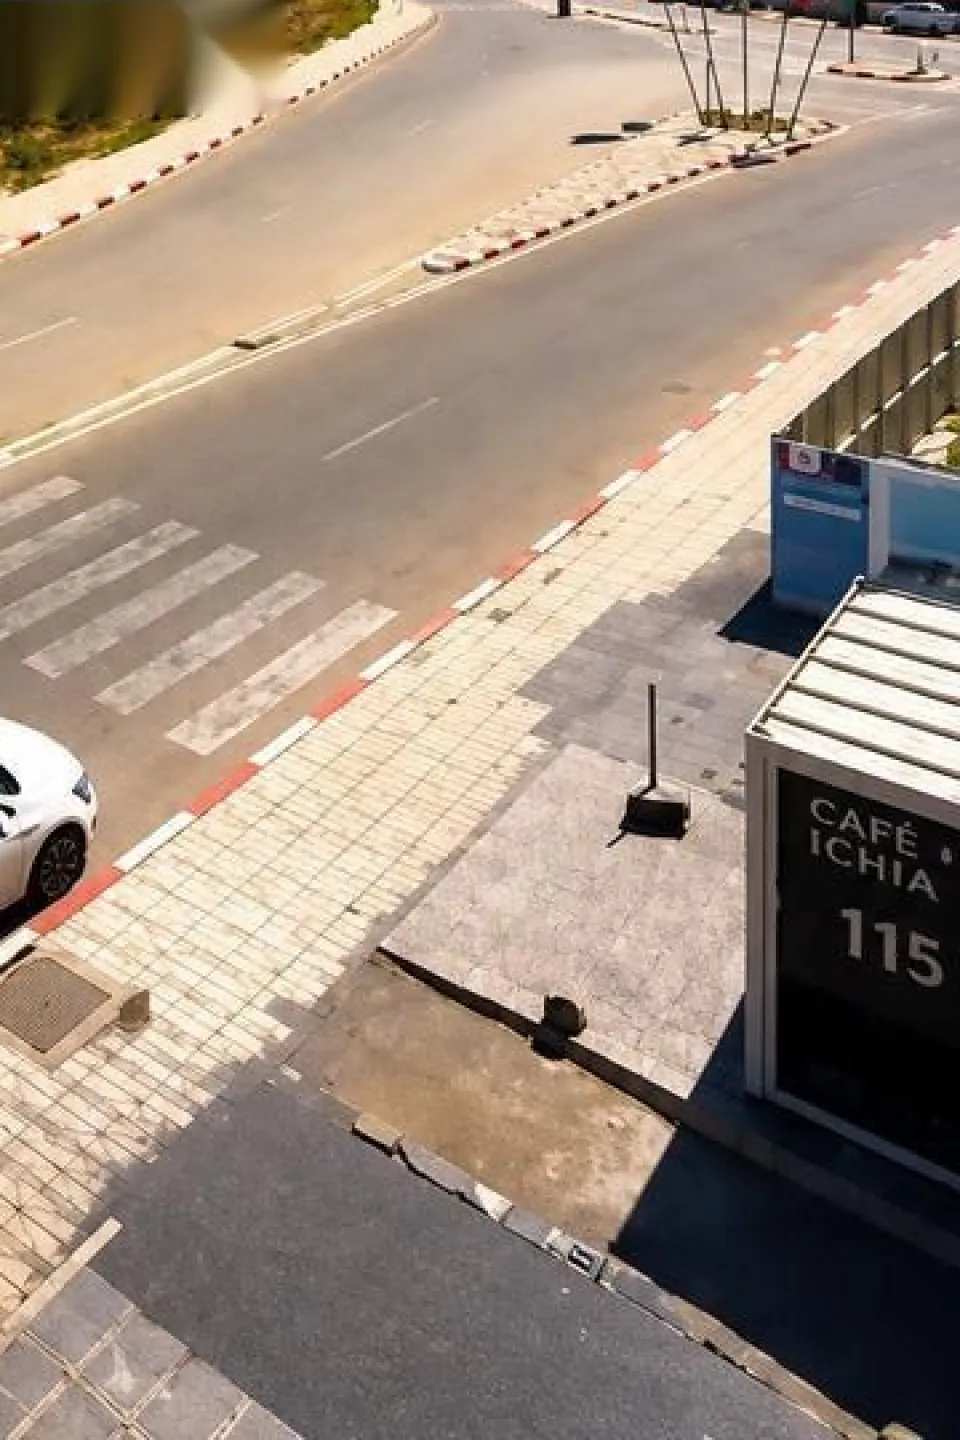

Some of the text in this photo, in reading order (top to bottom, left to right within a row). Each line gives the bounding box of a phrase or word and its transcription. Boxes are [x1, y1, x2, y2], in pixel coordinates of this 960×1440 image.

[810, 799, 918, 859] CAFÉ
[810, 828, 939, 902] ICHIA
[841, 908, 944, 987] 115
